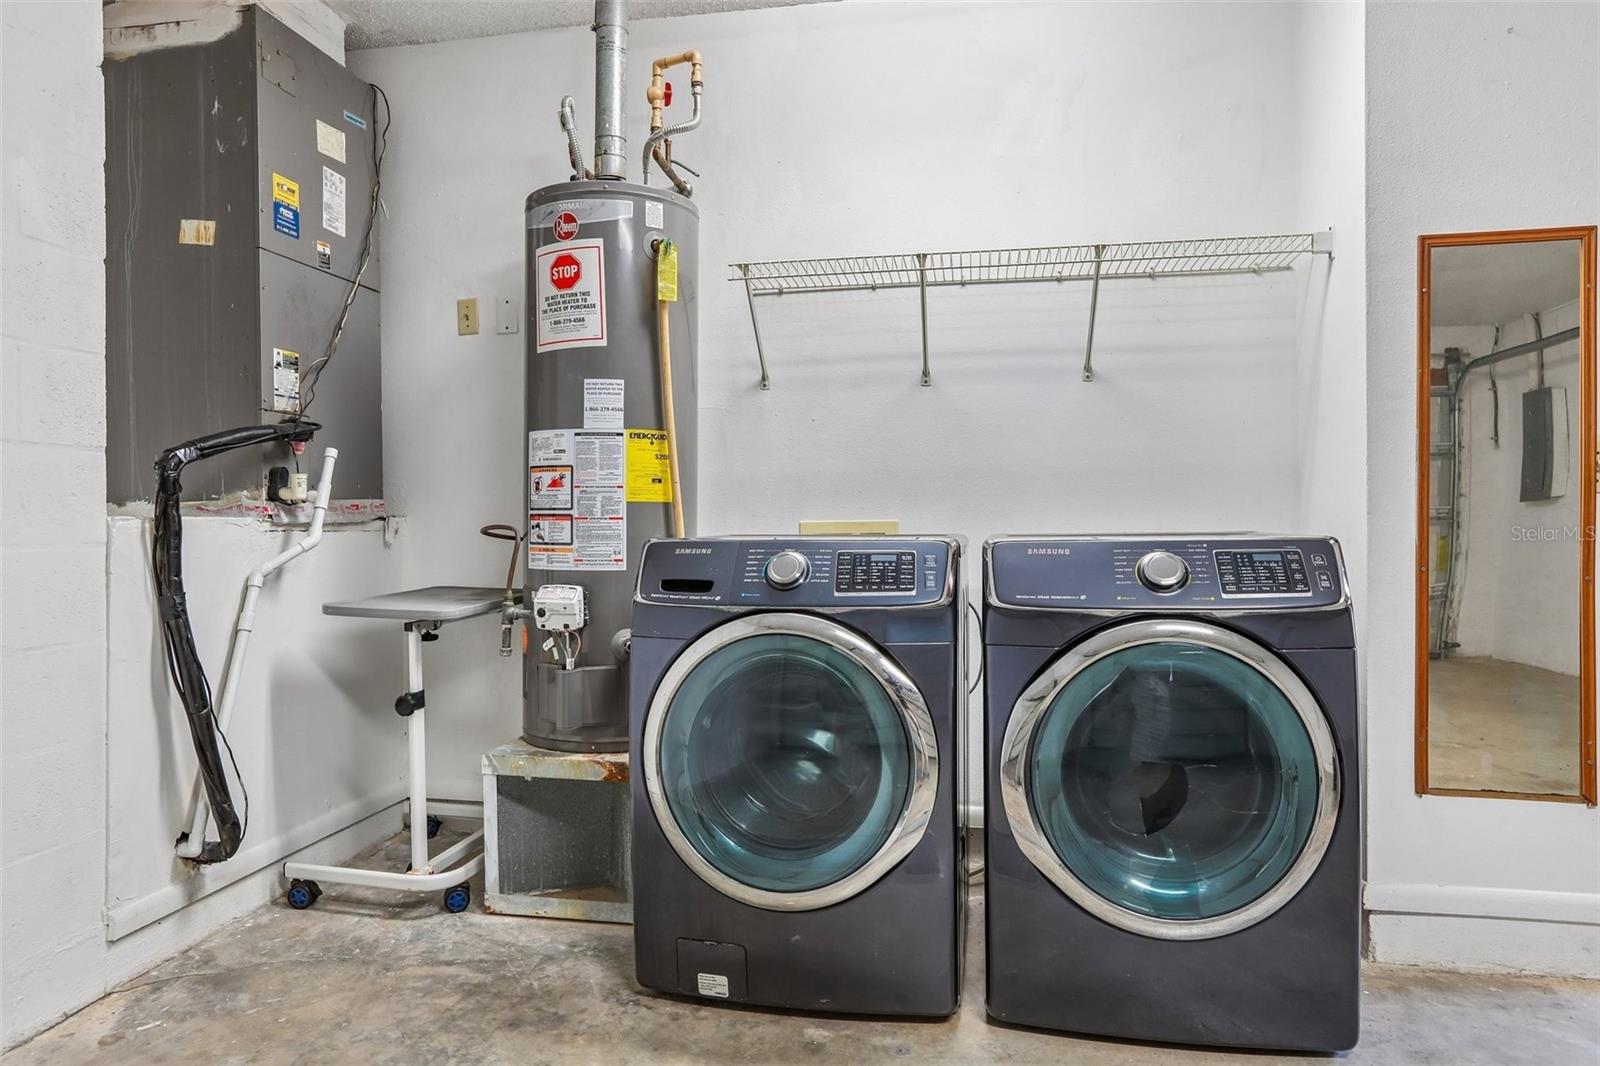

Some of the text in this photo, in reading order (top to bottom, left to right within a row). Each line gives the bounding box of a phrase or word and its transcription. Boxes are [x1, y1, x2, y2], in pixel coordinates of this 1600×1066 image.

[556, 213, 577, 238] Rheem
[552, 265, 578, 280] STOP
[629, 432, 668, 441] ENERGYGUID
[674, 547, 713, 555] SAMSUNG
[1027, 547, 1071, 555] SAMSUNG
